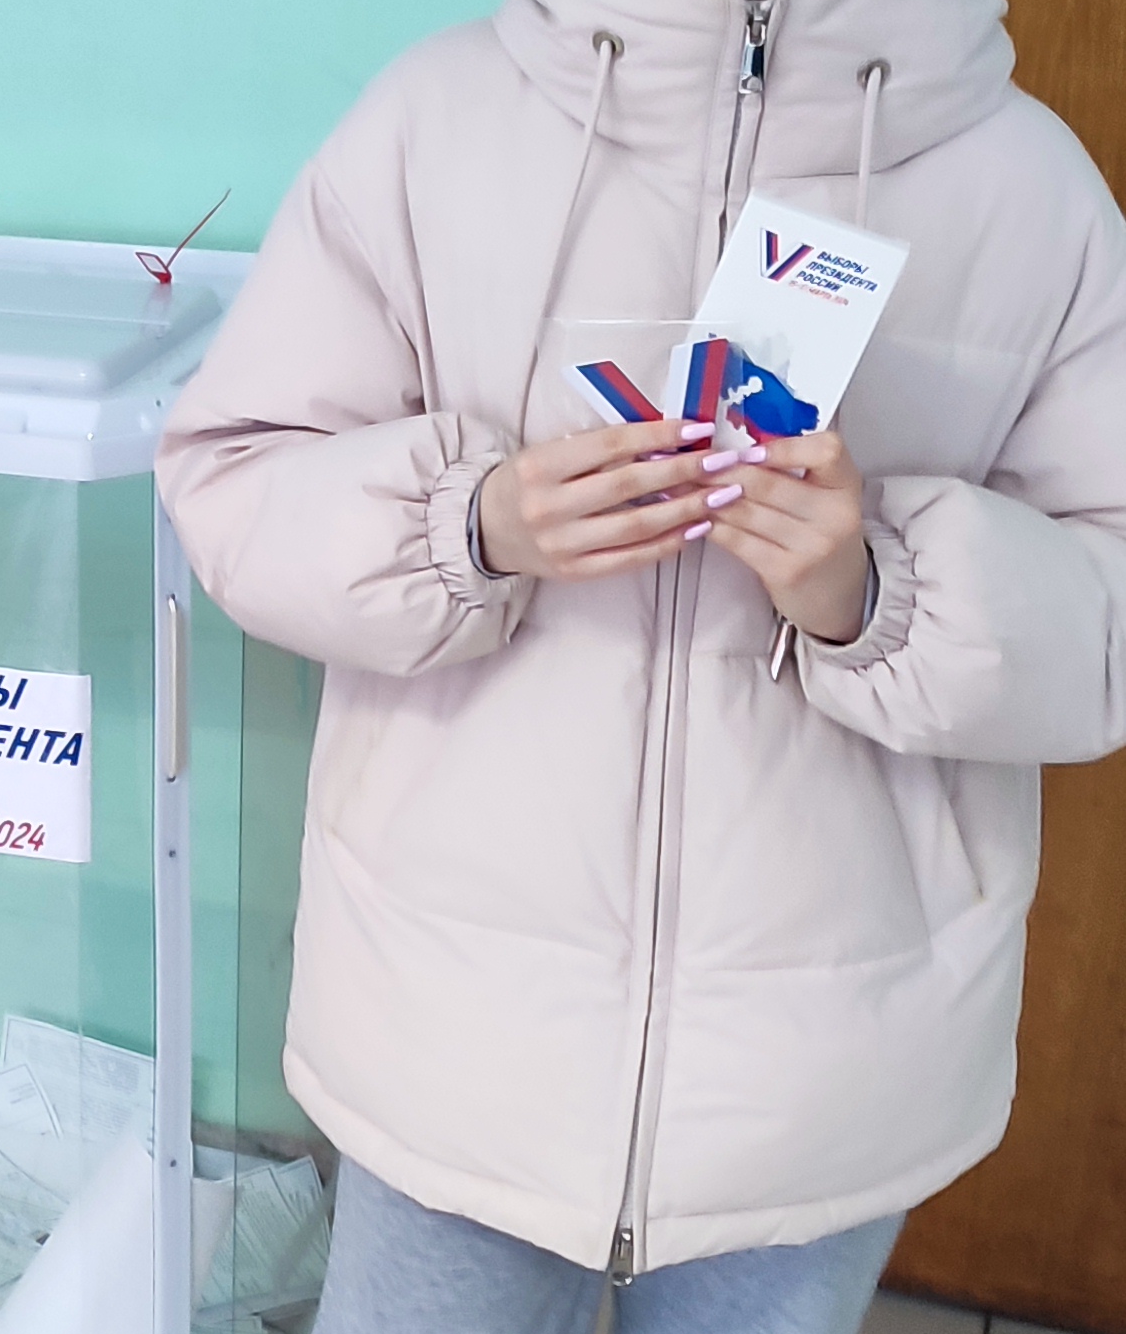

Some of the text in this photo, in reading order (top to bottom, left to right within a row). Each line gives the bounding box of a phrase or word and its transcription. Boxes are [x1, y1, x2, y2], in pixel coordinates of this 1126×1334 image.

[817, 251, 869, 275] ВЫБОРЫ
[797, 270, 843, 292] РОССИИ
[806, 261, 878, 292] ПРЕЗИДЕНТА
